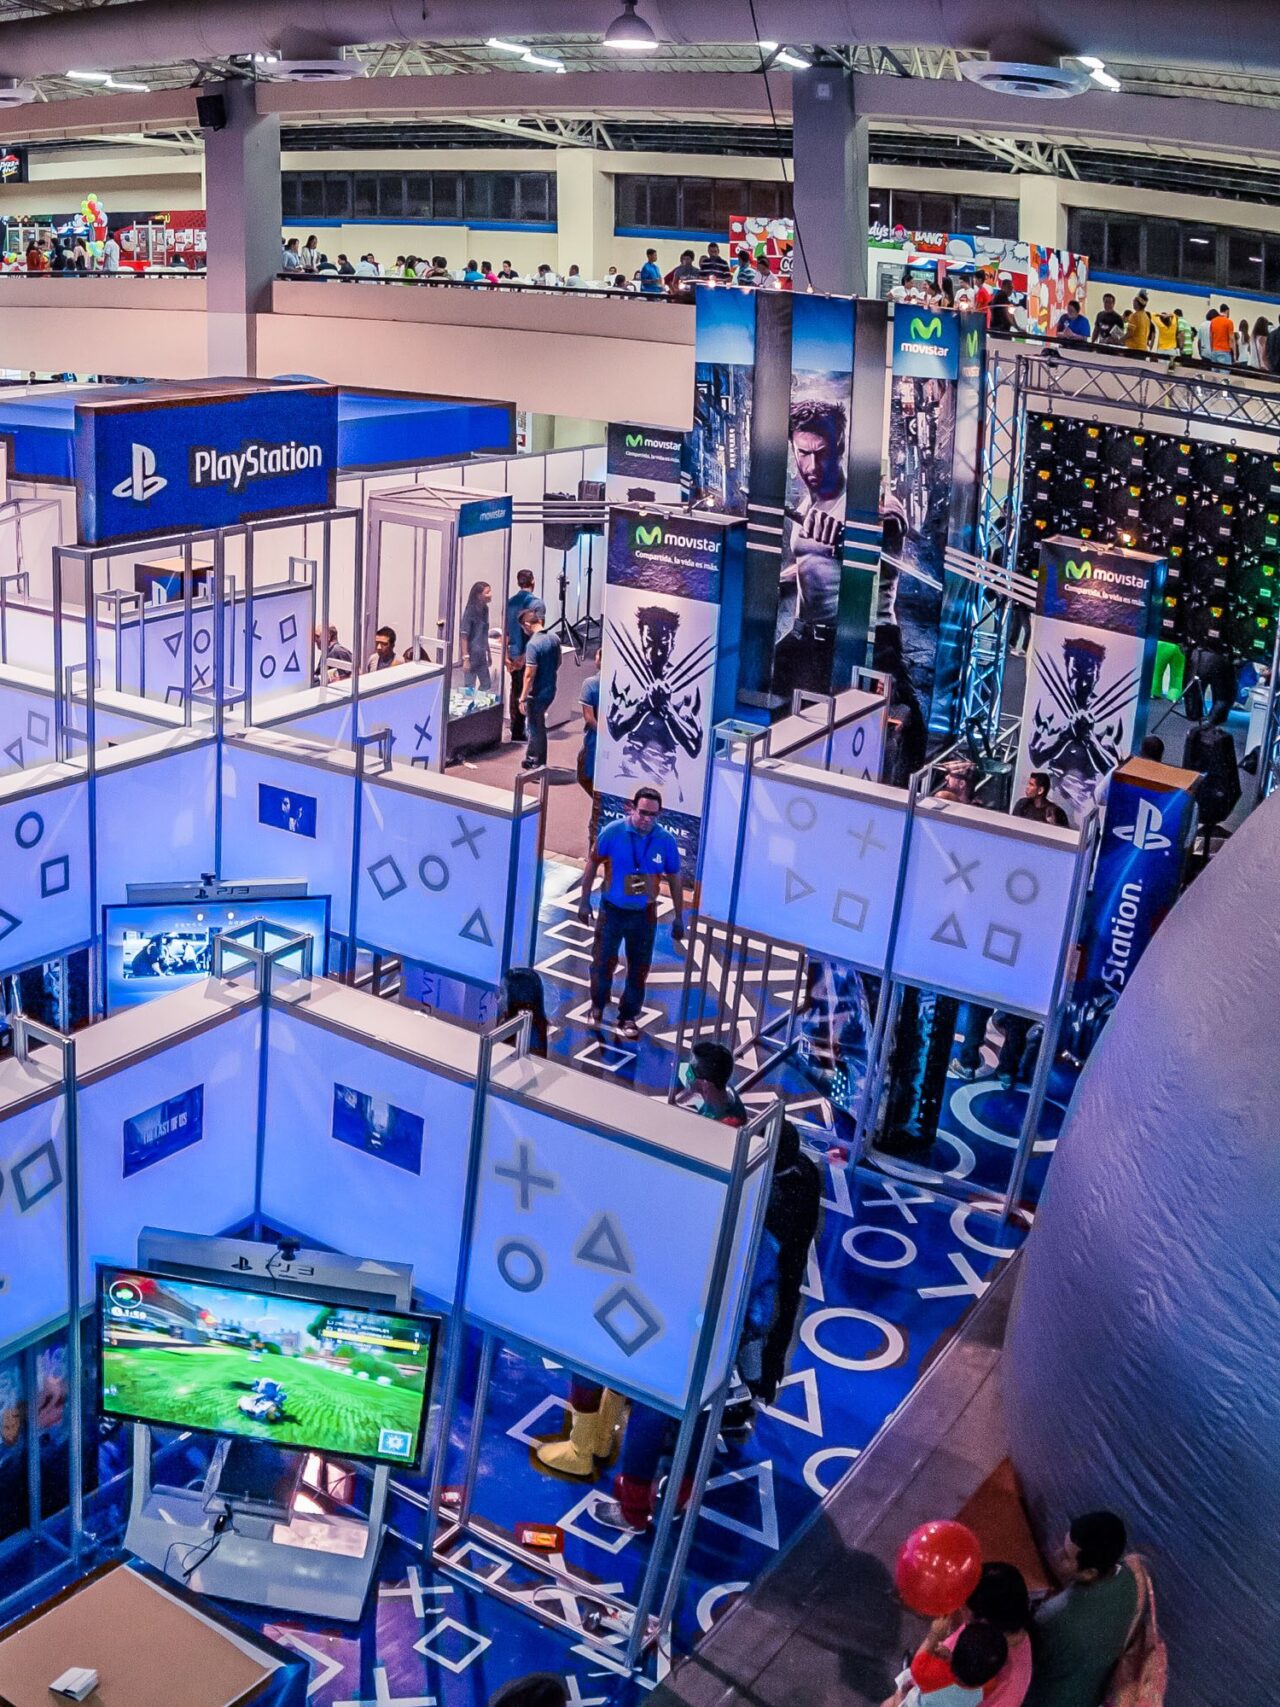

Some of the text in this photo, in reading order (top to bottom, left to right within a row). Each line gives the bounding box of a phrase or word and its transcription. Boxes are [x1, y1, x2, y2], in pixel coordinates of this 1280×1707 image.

[914, 231, 944, 246] BANG
[900, 342, 949, 358] movistar
[644, 439, 681, 451] movistar
[195, 441, 322, 488] PlayStation
[664, 534, 721, 553] movistar
[1093, 569, 1149, 590] movistar
[216, 887, 249, 895] PS3
[271, 1259, 314, 1277] PS3
